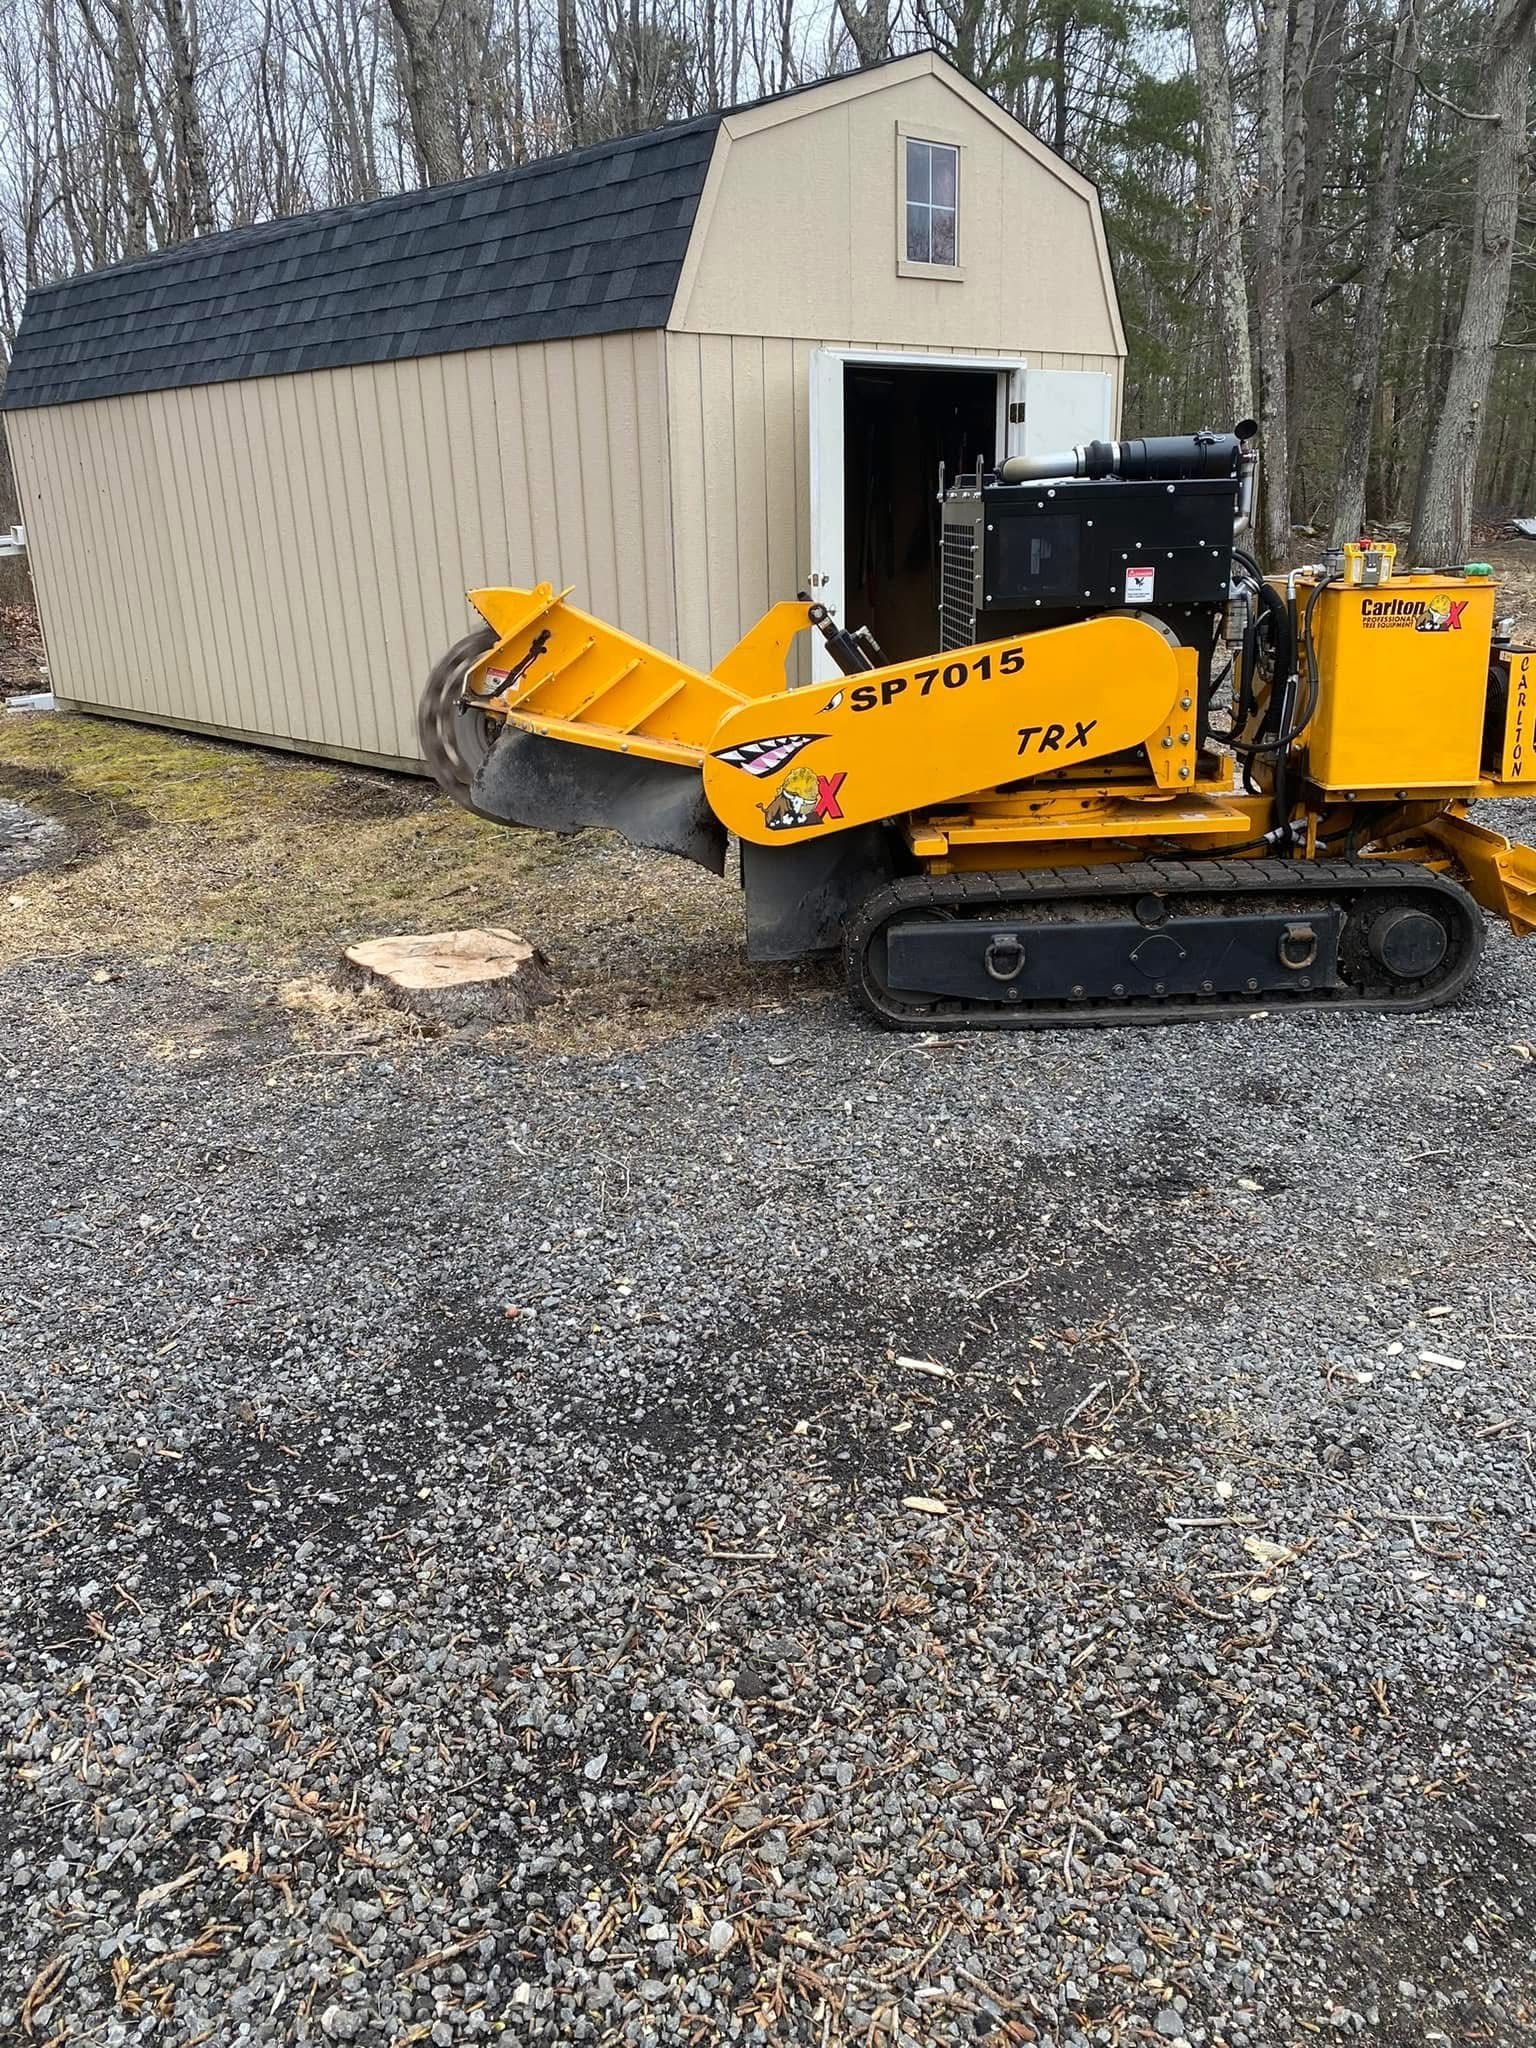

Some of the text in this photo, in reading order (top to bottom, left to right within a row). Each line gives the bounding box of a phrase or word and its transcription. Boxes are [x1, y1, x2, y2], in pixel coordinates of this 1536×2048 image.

[1361, 598, 1426, 616] Carlton
[1362, 615, 1417, 623] PROFESSIONAL
[1511, 656, 1530, 778] CARLTON
[1017, 719, 1098, 756] TRX
